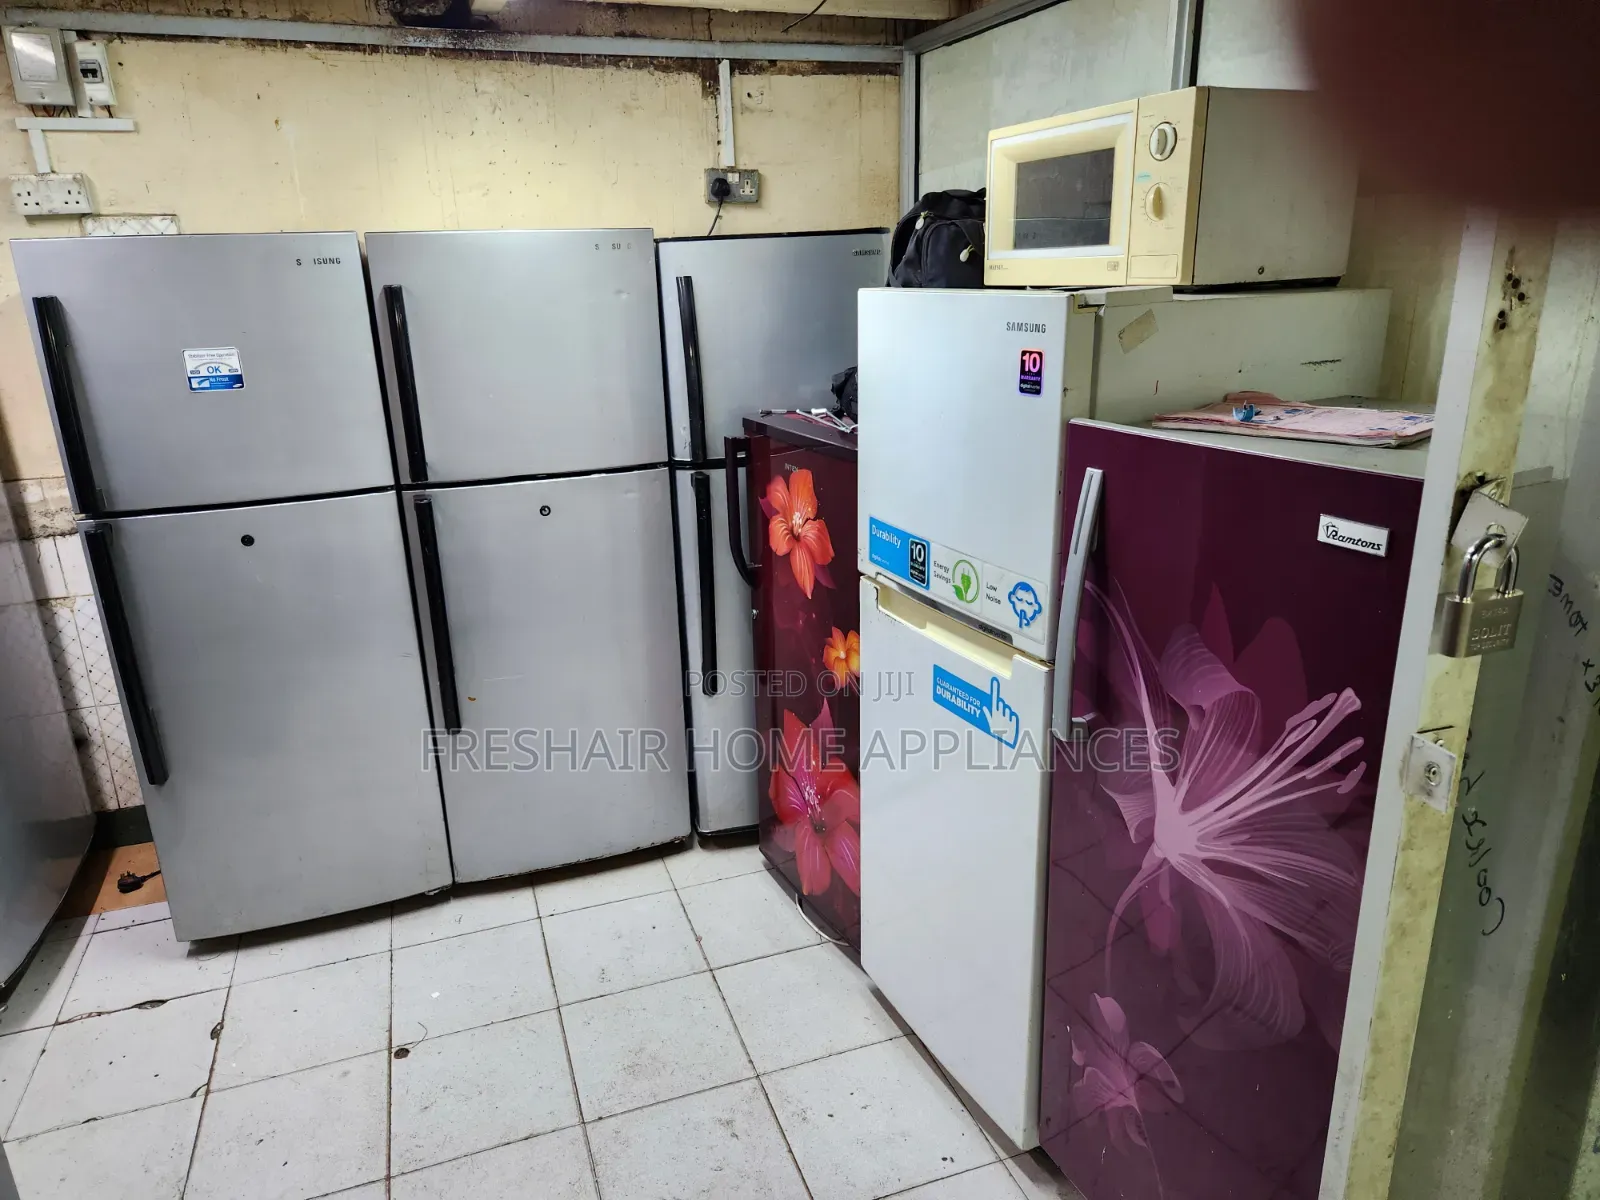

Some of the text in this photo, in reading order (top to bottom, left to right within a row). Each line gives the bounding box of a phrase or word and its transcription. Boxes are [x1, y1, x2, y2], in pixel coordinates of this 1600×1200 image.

[1006, 321, 1047, 334] SAMSUNG
[206, 365, 222, 375] OK
[1022, 352, 1041, 373] 10
[871, 524, 902, 549] Durability
[1326, 525, 1383, 551] Ramtons
[911, 543, 925, 563] 10
[933, 560, 950, 574] Energy
[933, 571, 952, 584] Savings
[986, 581, 998, 592] Low
[985, 594, 1002, 605] Noise
[936, 677, 981, 708] GUARANTEED FOR
[936, 685, 982, 719] DURABILITY
